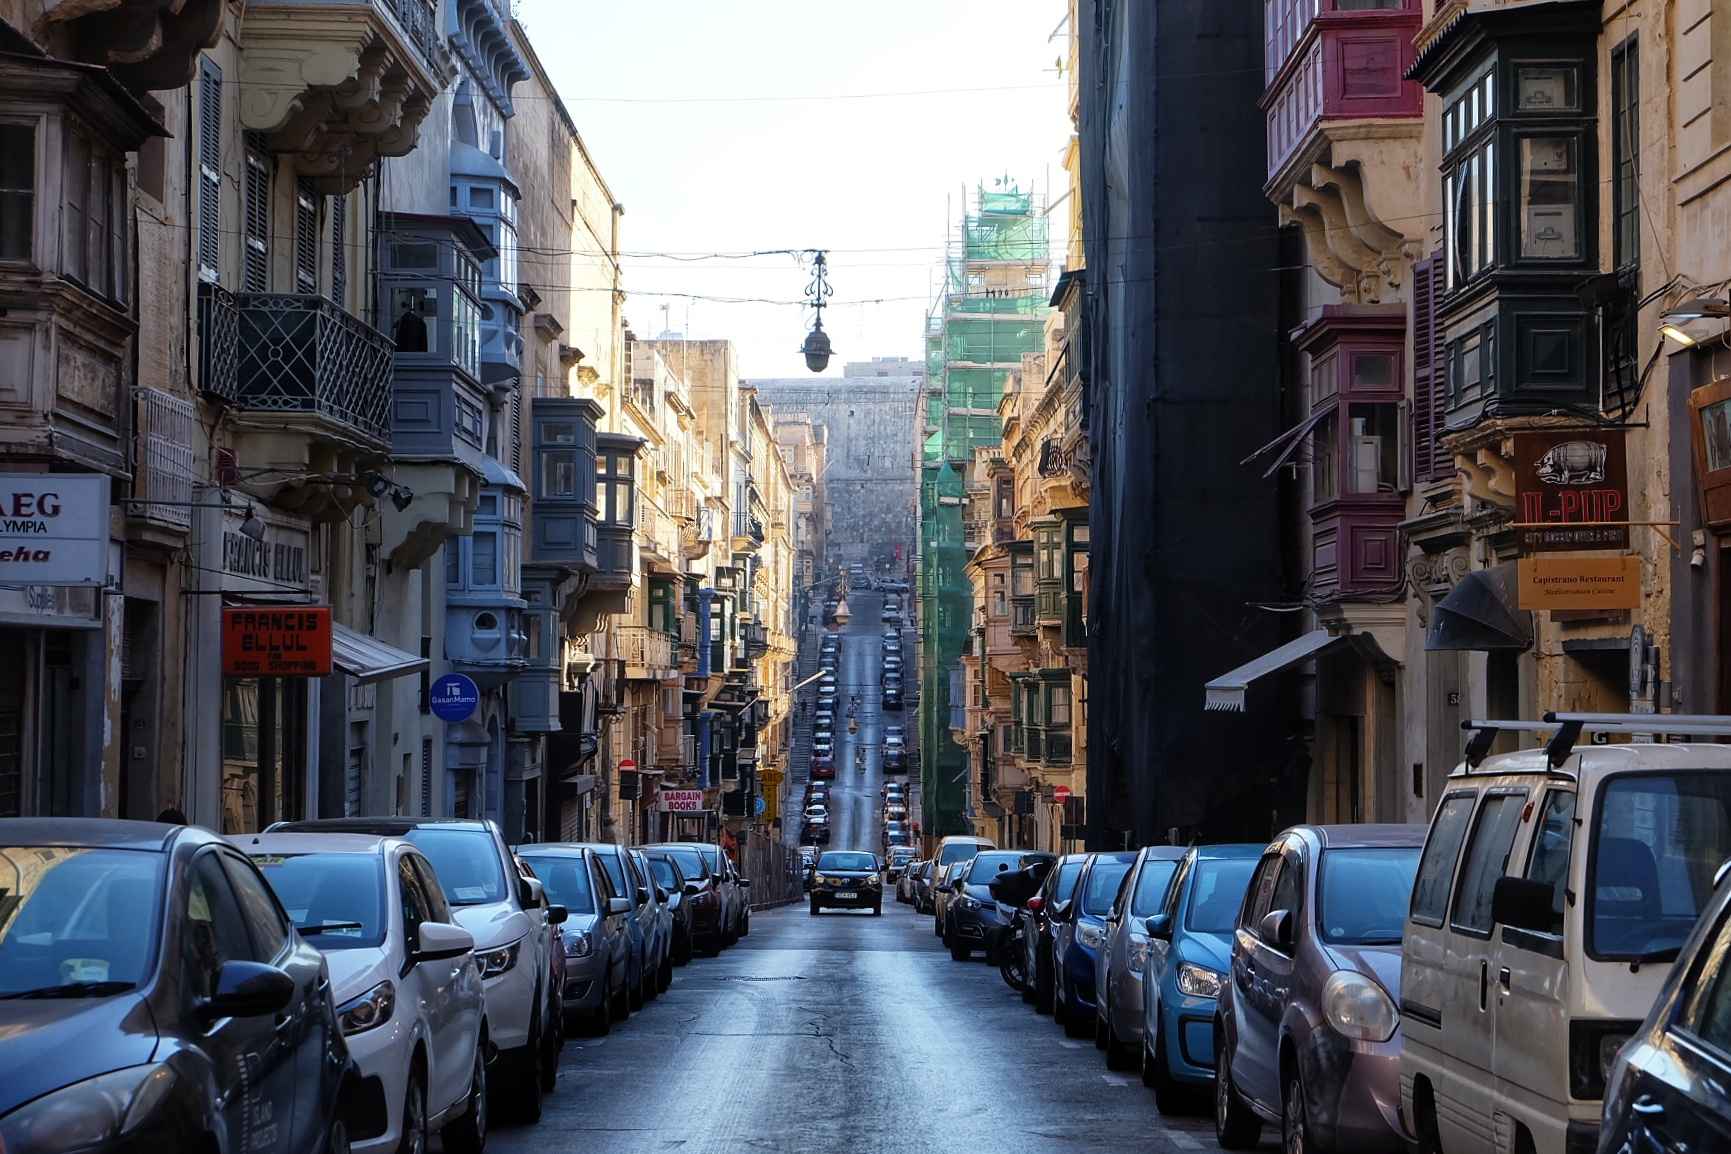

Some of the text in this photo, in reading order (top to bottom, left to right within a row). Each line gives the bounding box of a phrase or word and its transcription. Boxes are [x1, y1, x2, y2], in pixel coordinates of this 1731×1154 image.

[223, 531, 271, 578] FRANCIS
[1579, 575, 1624, 584] Restaurant
[232, 613, 318, 631] FRANCIS
[664, 791, 701, 801] BARGAIN
[668, 801, 697, 810] BOOKS
